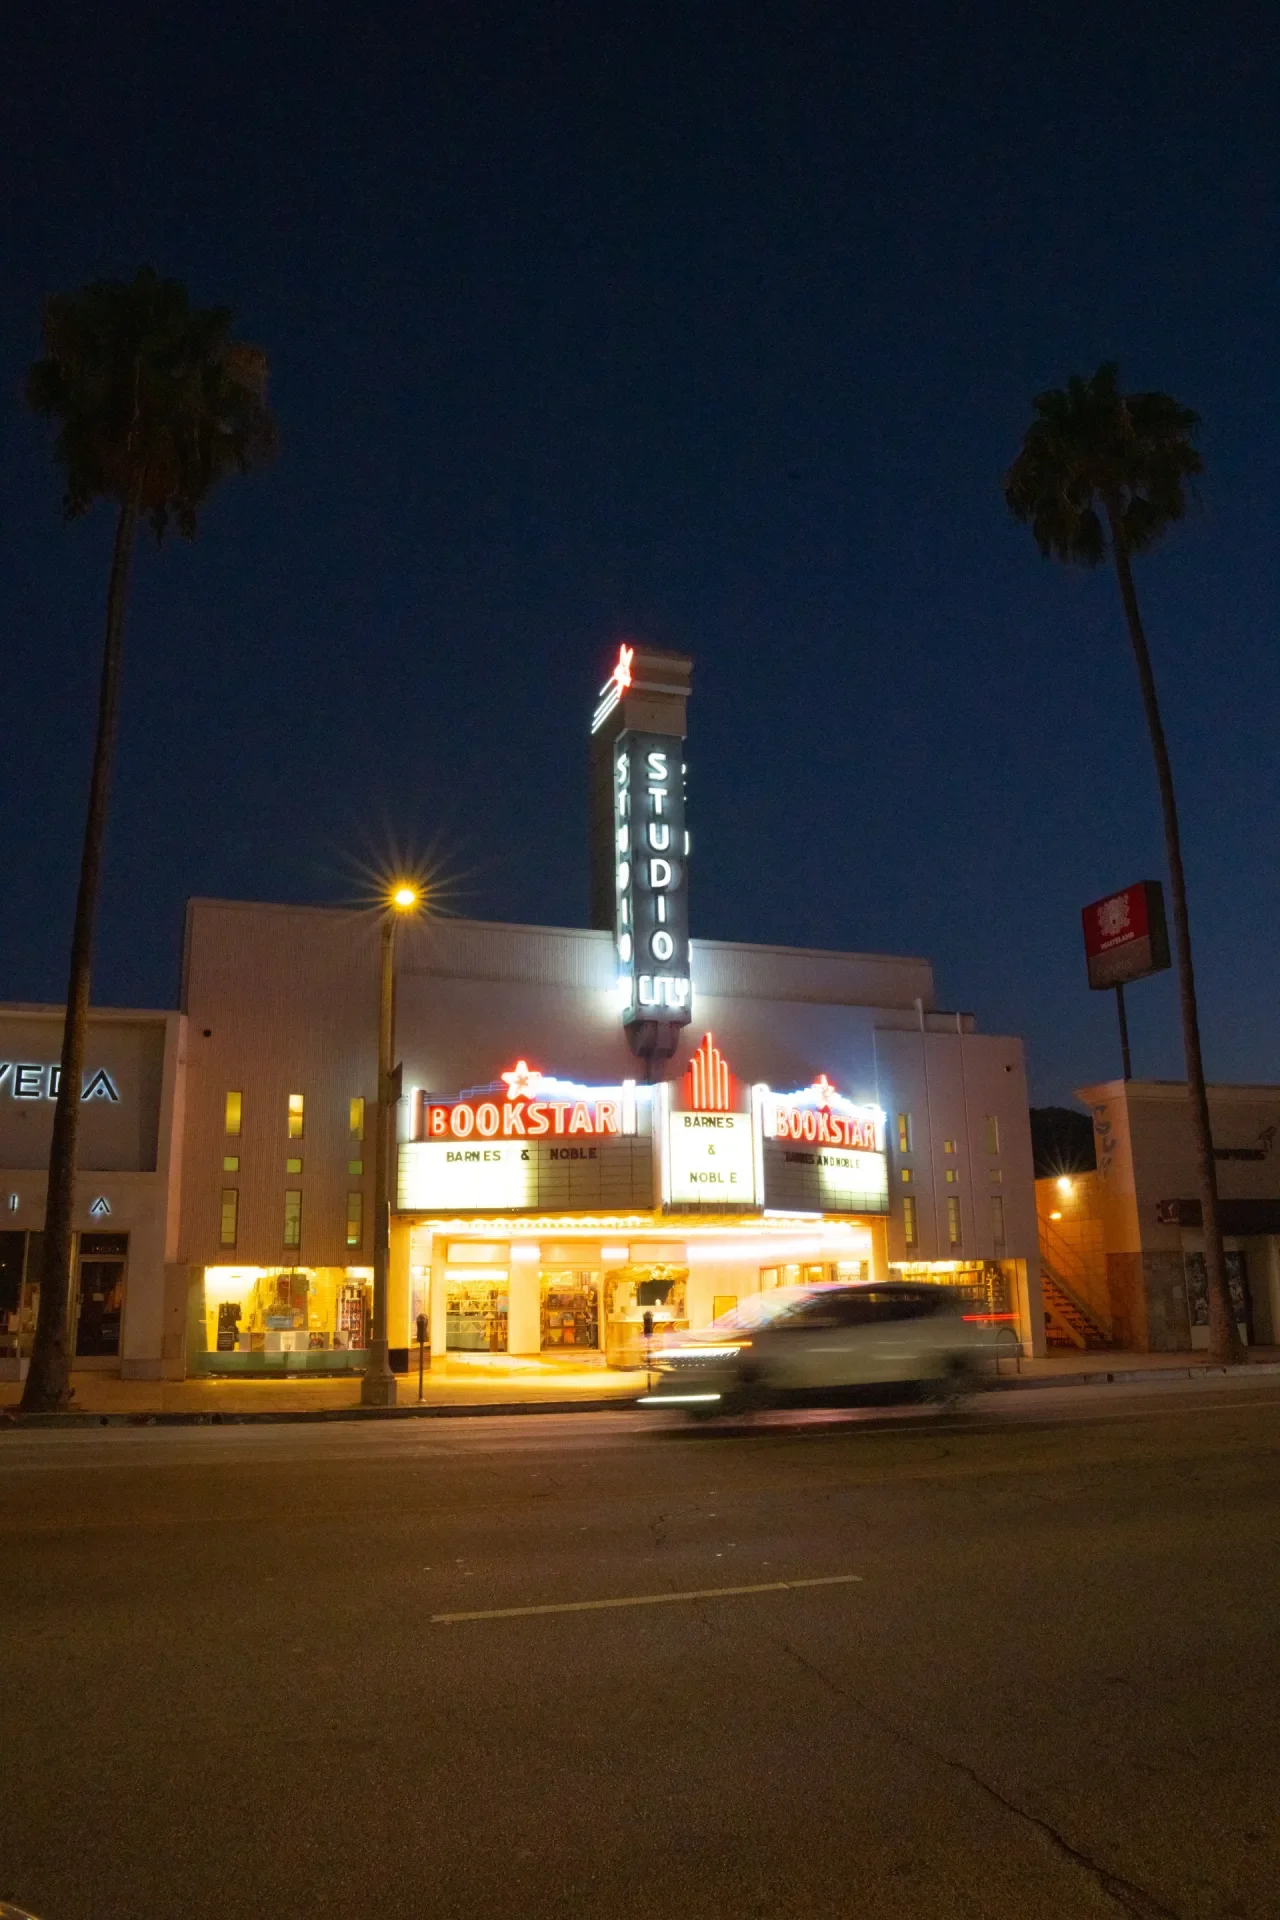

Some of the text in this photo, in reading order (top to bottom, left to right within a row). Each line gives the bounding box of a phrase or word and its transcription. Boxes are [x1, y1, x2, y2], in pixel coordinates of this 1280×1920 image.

[648, 752, 673, 961] STUDIO
[638, 974, 689, 1007] CITY
[428, 1101, 619, 1138] BOOKSTAR
[683, 1116, 734, 1129] BARNES
[775, 1106, 875, 1148] BOOKSTAR
[446, 1147, 597, 1163] BARNES & NOBLE
[707, 1144, 717, 1156] &
[689, 1172, 737, 1184] NOBLE
